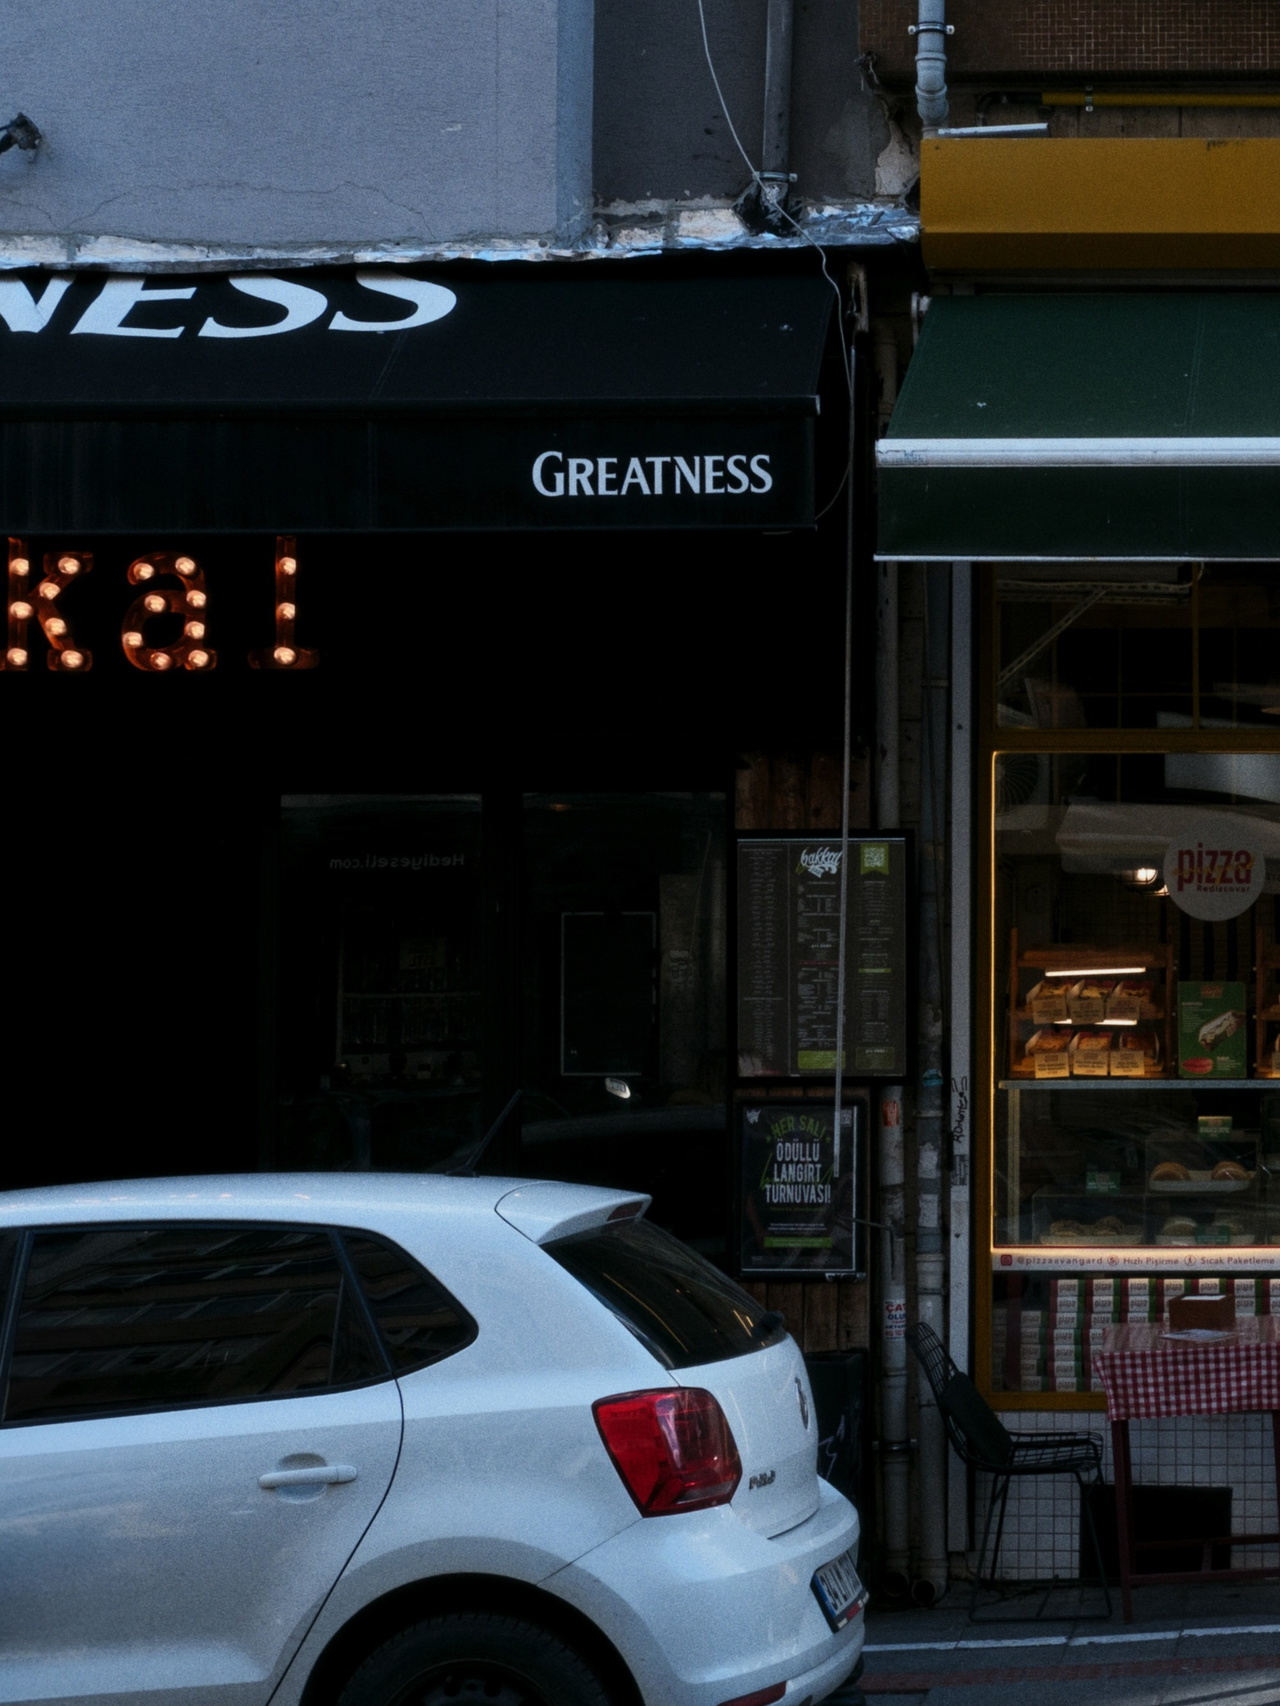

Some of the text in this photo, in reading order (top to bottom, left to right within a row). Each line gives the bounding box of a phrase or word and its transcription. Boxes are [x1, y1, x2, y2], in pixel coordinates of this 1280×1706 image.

[531, 450, 773, 497] GREATNESS
[1177, 842, 1251, 892] pizza
[771, 1115, 795, 1139] HER
[776, 1138, 820, 1162] ÖDÜLLÜ
[1227, 1256, 1275, 1265] Paketleme
